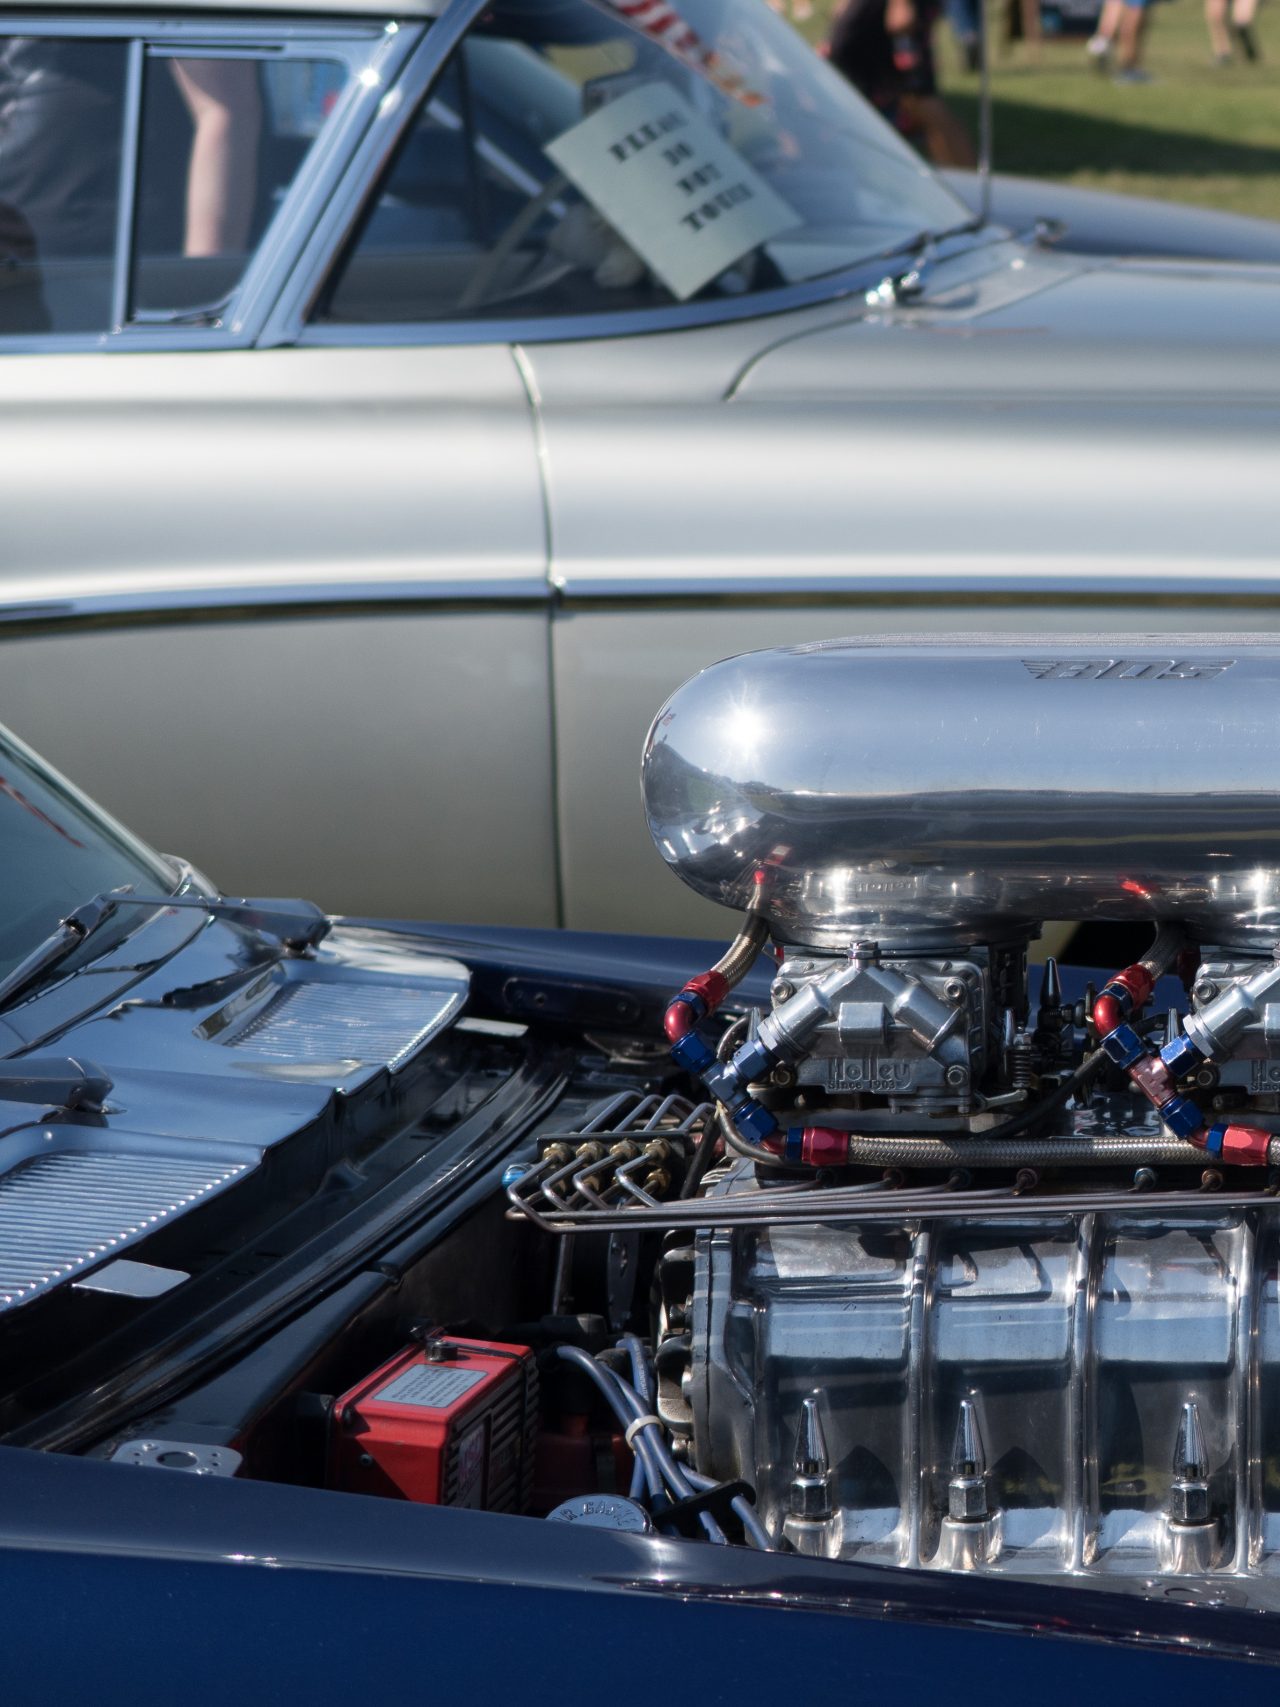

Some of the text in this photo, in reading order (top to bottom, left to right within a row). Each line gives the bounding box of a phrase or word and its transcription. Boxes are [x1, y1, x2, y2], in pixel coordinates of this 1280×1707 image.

[828, 1057, 912, 1089] Holley
[828, 1080, 897, 1091] Since 1903
